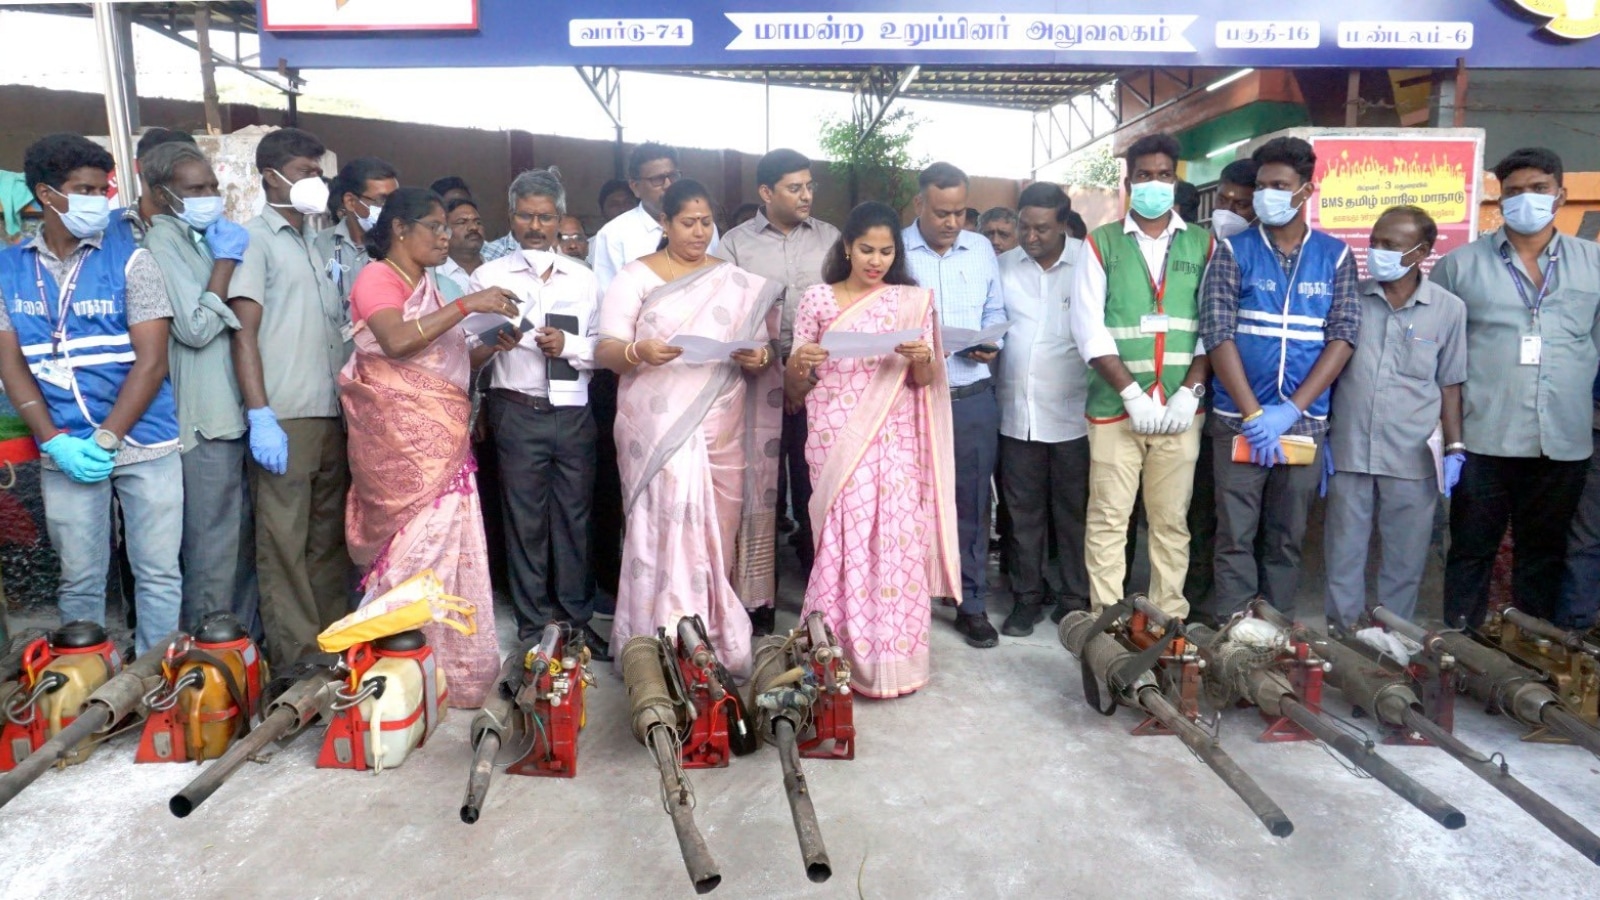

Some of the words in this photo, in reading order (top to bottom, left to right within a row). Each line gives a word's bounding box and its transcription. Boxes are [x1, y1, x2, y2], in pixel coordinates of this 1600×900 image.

[580, 20, 685, 42] வார்டு-74
[754, 14, 864, 45] மாமன்ற
[880, 15, 1011, 46] உறுப்பினர்
[1025, 17, 1172, 48] அலுவலகம்
[1226, 23, 1310, 45] பகுதி-16
[1384, 181, 1392, 190] 3
[1321, 196, 1343, 209] BMS
[1345, 194, 1378, 209] தமிழ்
[1381, 192, 1418, 206] மாநில
[1421, 191, 1465, 205] மாநாடு
